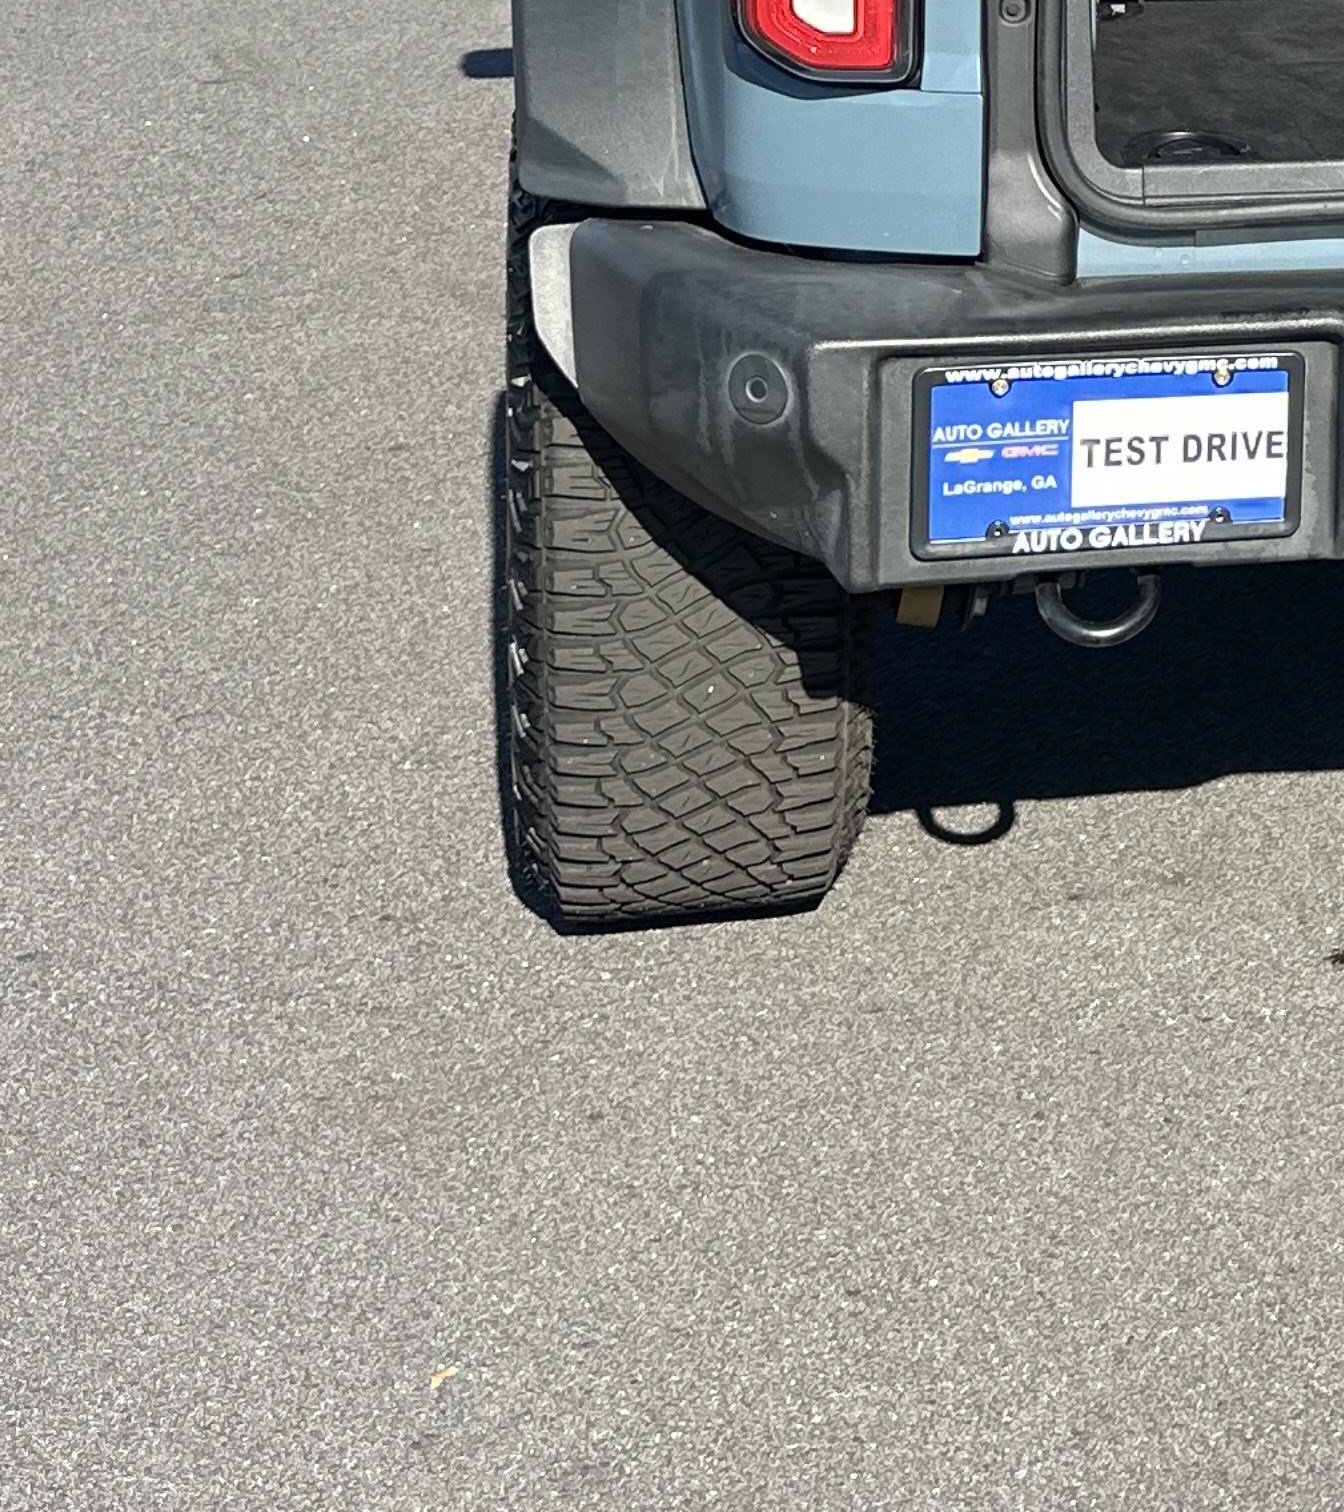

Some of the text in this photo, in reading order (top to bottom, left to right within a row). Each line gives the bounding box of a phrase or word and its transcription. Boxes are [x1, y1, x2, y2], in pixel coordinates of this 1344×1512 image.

[945, 356, 1278, 383] www.autogallerychevygmc.com
[934, 419, 1070, 442] AUTO GALLERY
[1002, 444, 1059, 458] GMC
[1080, 430, 1284, 468] TEST DRIVE
[943, 475, 1057, 496] LaGrange, GA
[1012, 518, 1210, 554] AUTO GALLERY
